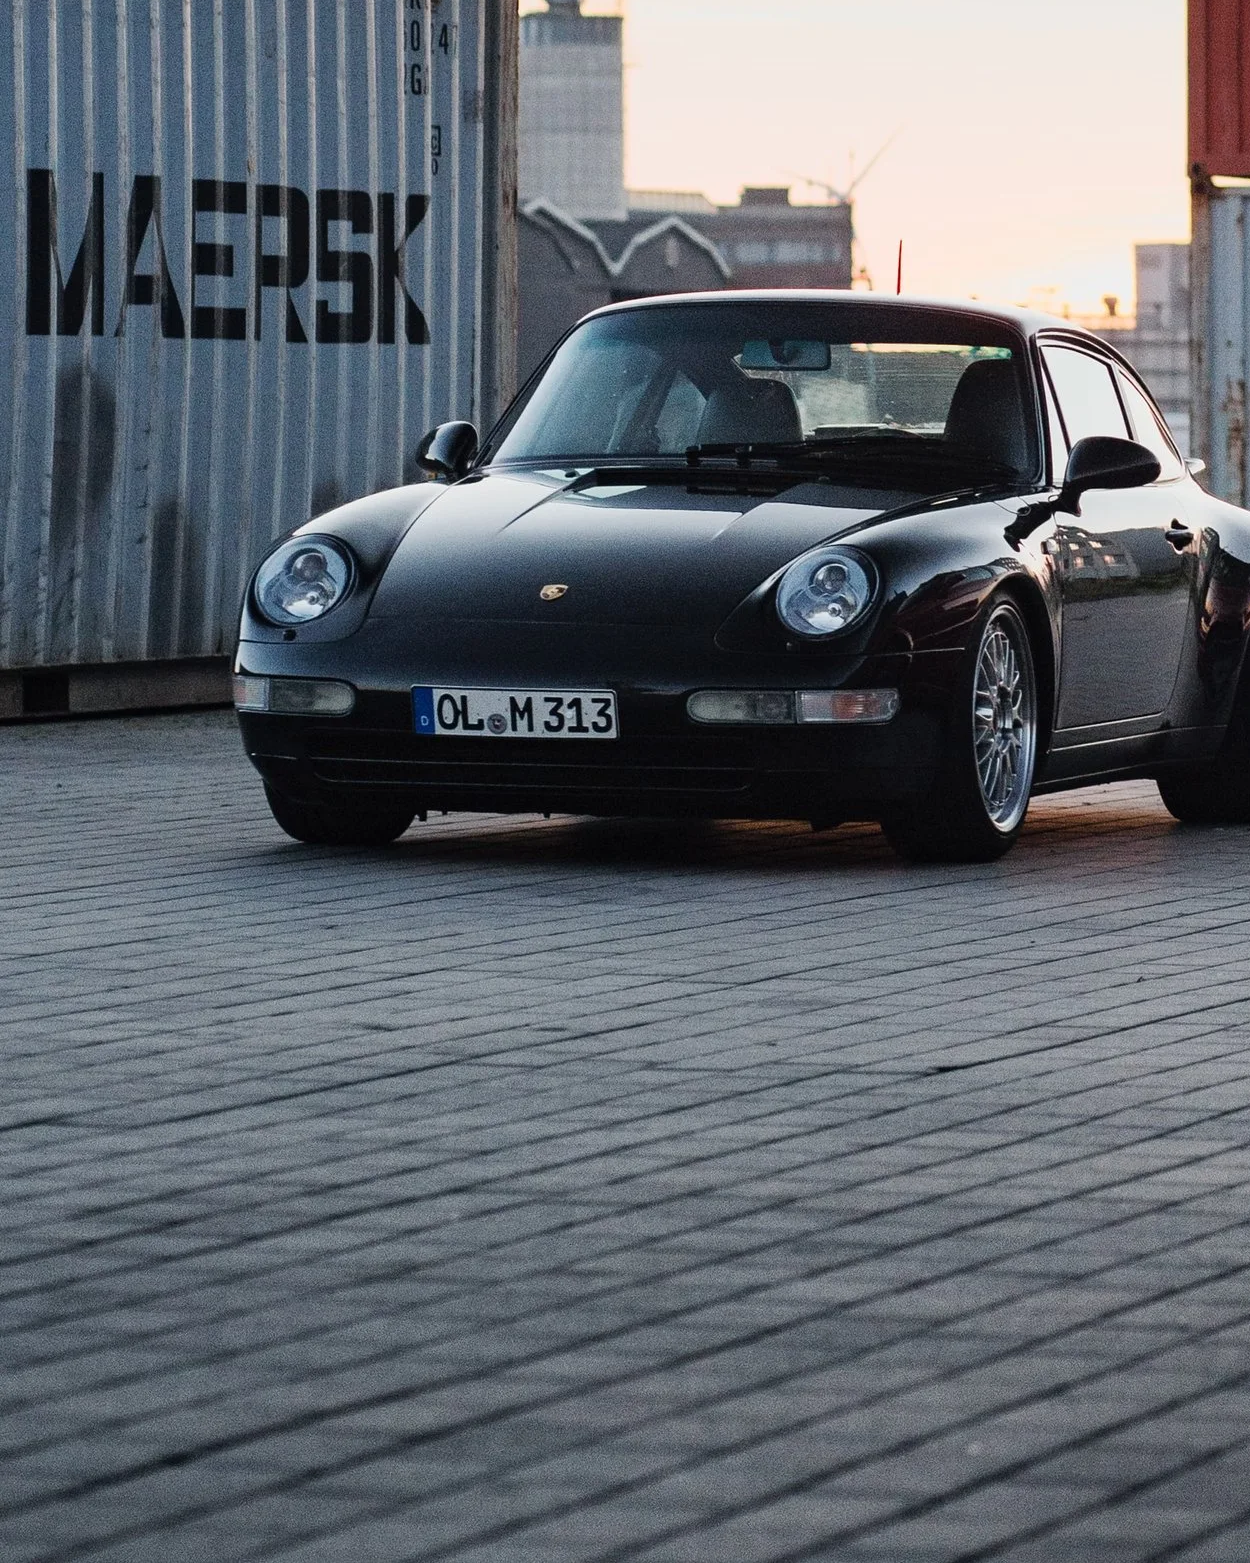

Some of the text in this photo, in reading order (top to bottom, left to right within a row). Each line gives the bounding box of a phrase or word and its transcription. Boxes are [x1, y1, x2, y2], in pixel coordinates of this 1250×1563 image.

[26, 168, 431, 345] MAERSK
[421, 715, 429, 726] D
[437, 693, 613, 733] OL M 313
